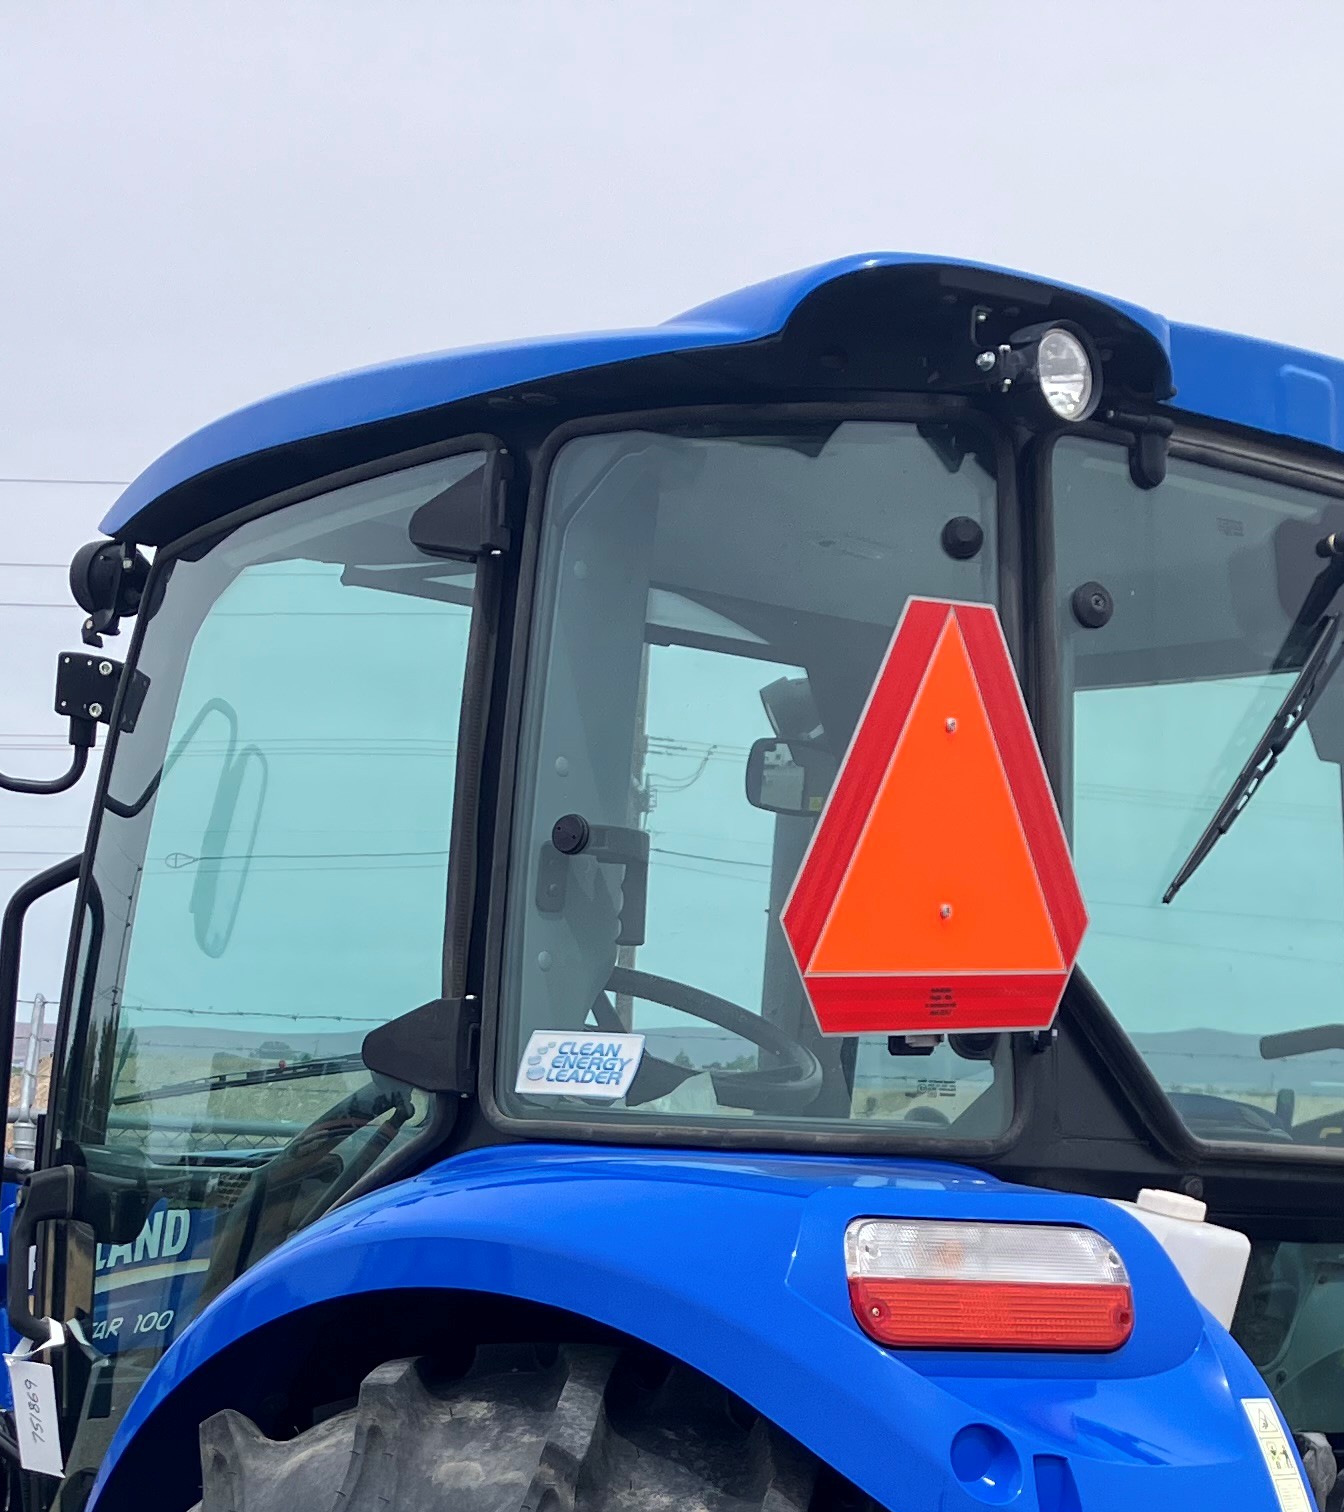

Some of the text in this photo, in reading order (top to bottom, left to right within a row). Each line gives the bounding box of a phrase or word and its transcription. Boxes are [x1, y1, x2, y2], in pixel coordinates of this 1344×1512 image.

[558, 1041, 622, 1057] CLEAN
[551, 1055, 633, 1072] ENERGY
[545, 1068, 624, 1086] LEADER
[133, 1309, 175, 1334] 100
[24, 1378, 46, 1444] 751869
